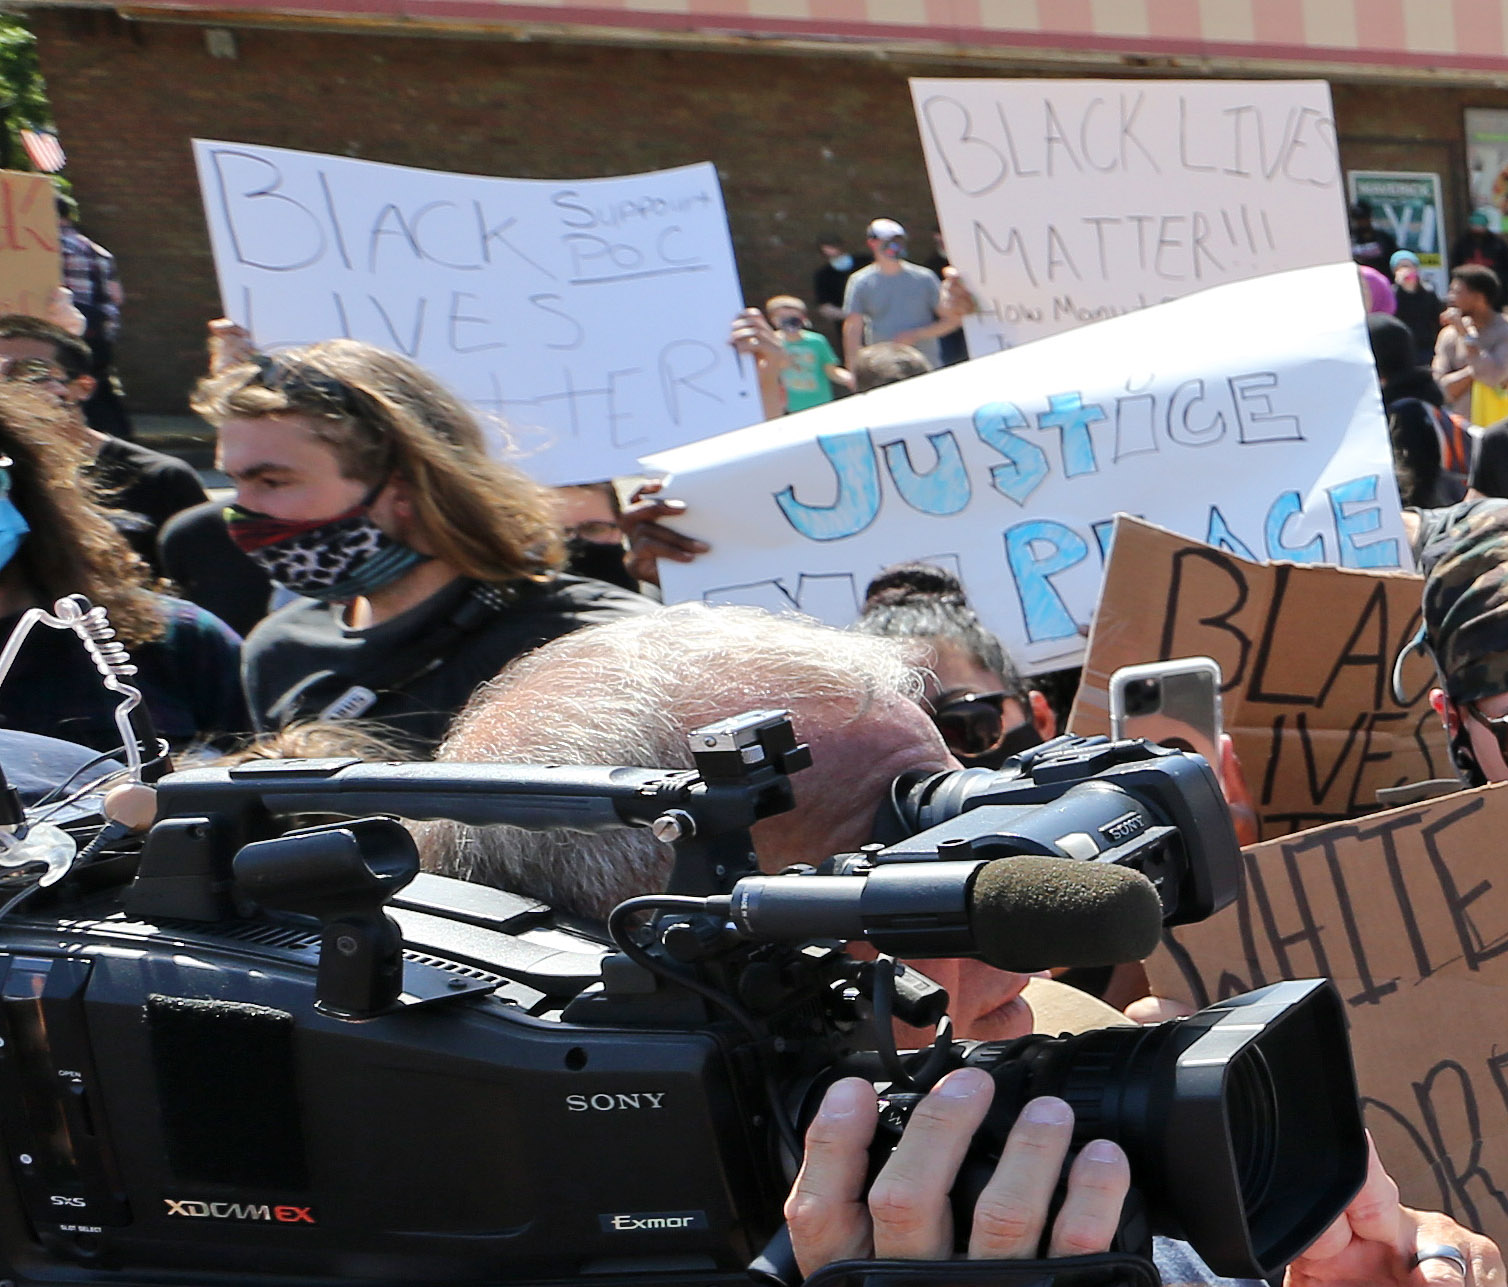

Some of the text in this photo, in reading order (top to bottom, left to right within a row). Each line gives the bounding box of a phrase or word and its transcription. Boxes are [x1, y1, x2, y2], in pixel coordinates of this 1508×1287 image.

[922, 91, 1338, 198] BLACK LIVES
[1159, 546, 1442, 711] BLAC
[1108, 815, 1145, 839] SONY
[58, 1069, 82, 1078] OPEN
[565, 1092, 666, 1112] SONY
[164, 1199, 317, 1224] XDCAM EX
[610, 1215, 695, 1230] Exmor
